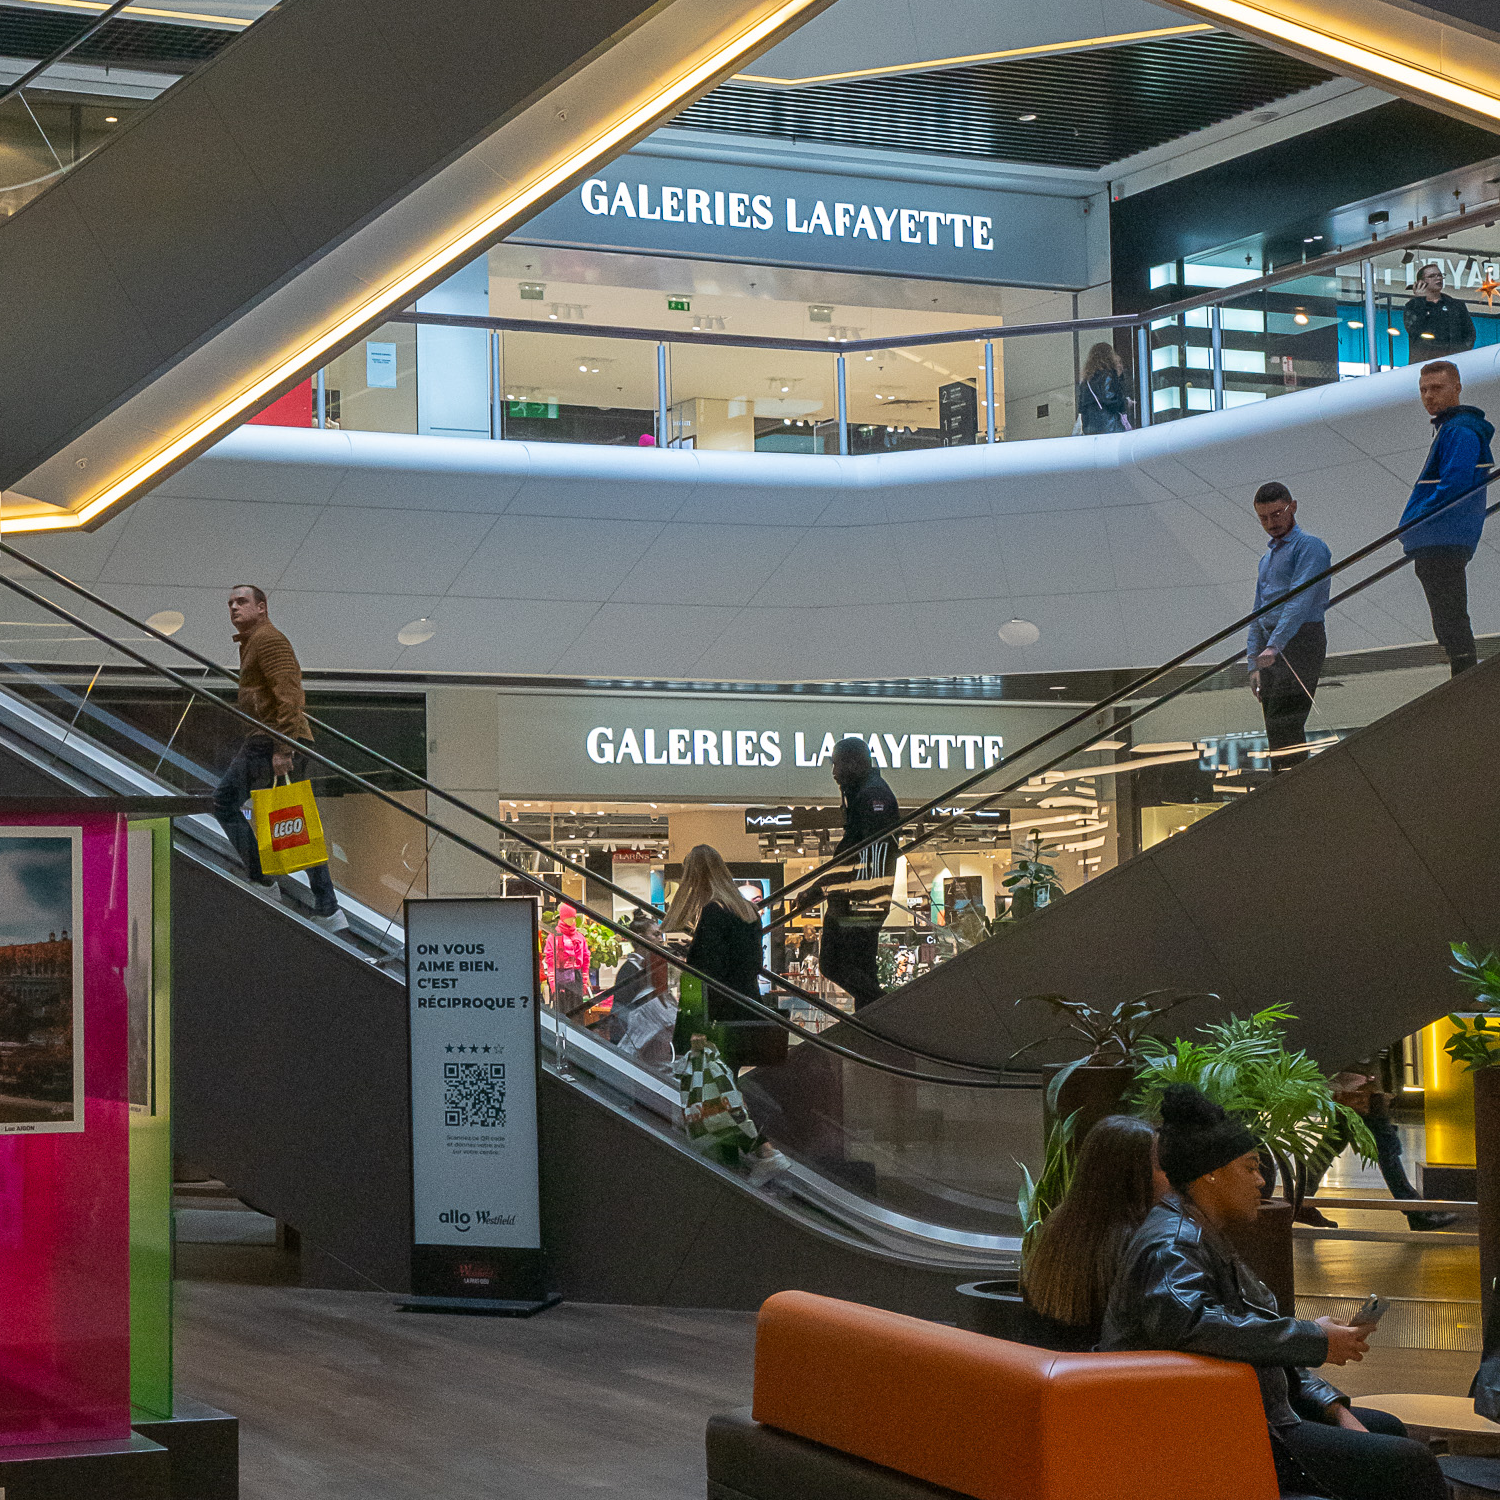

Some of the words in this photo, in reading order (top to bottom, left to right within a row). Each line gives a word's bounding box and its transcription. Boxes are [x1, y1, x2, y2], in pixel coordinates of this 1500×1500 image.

[581, 179, 774, 230] GALERIES
[786, 198, 994, 251] LAFAYETTE
[587, 727, 782, 767] GALERIES
[794, 731, 1005, 769] LAAYETTE
[747, 813, 792, 825] MAC
[274, 818, 303, 838] LEGO
[417, 944, 439, 955] ON
[443, 943, 485, 955] VOUS
[417, 961, 455, 972] AIME
[459, 961, 499, 972] BIEN.
[417, 978, 458, 989] C'EST
[418, 995, 515, 1010] RÉCIPROQUE
[520, 996, 529, 1008] ?
[439, 1209, 471, 1224] allo
[476, 1210, 516, 1225] Westfield
